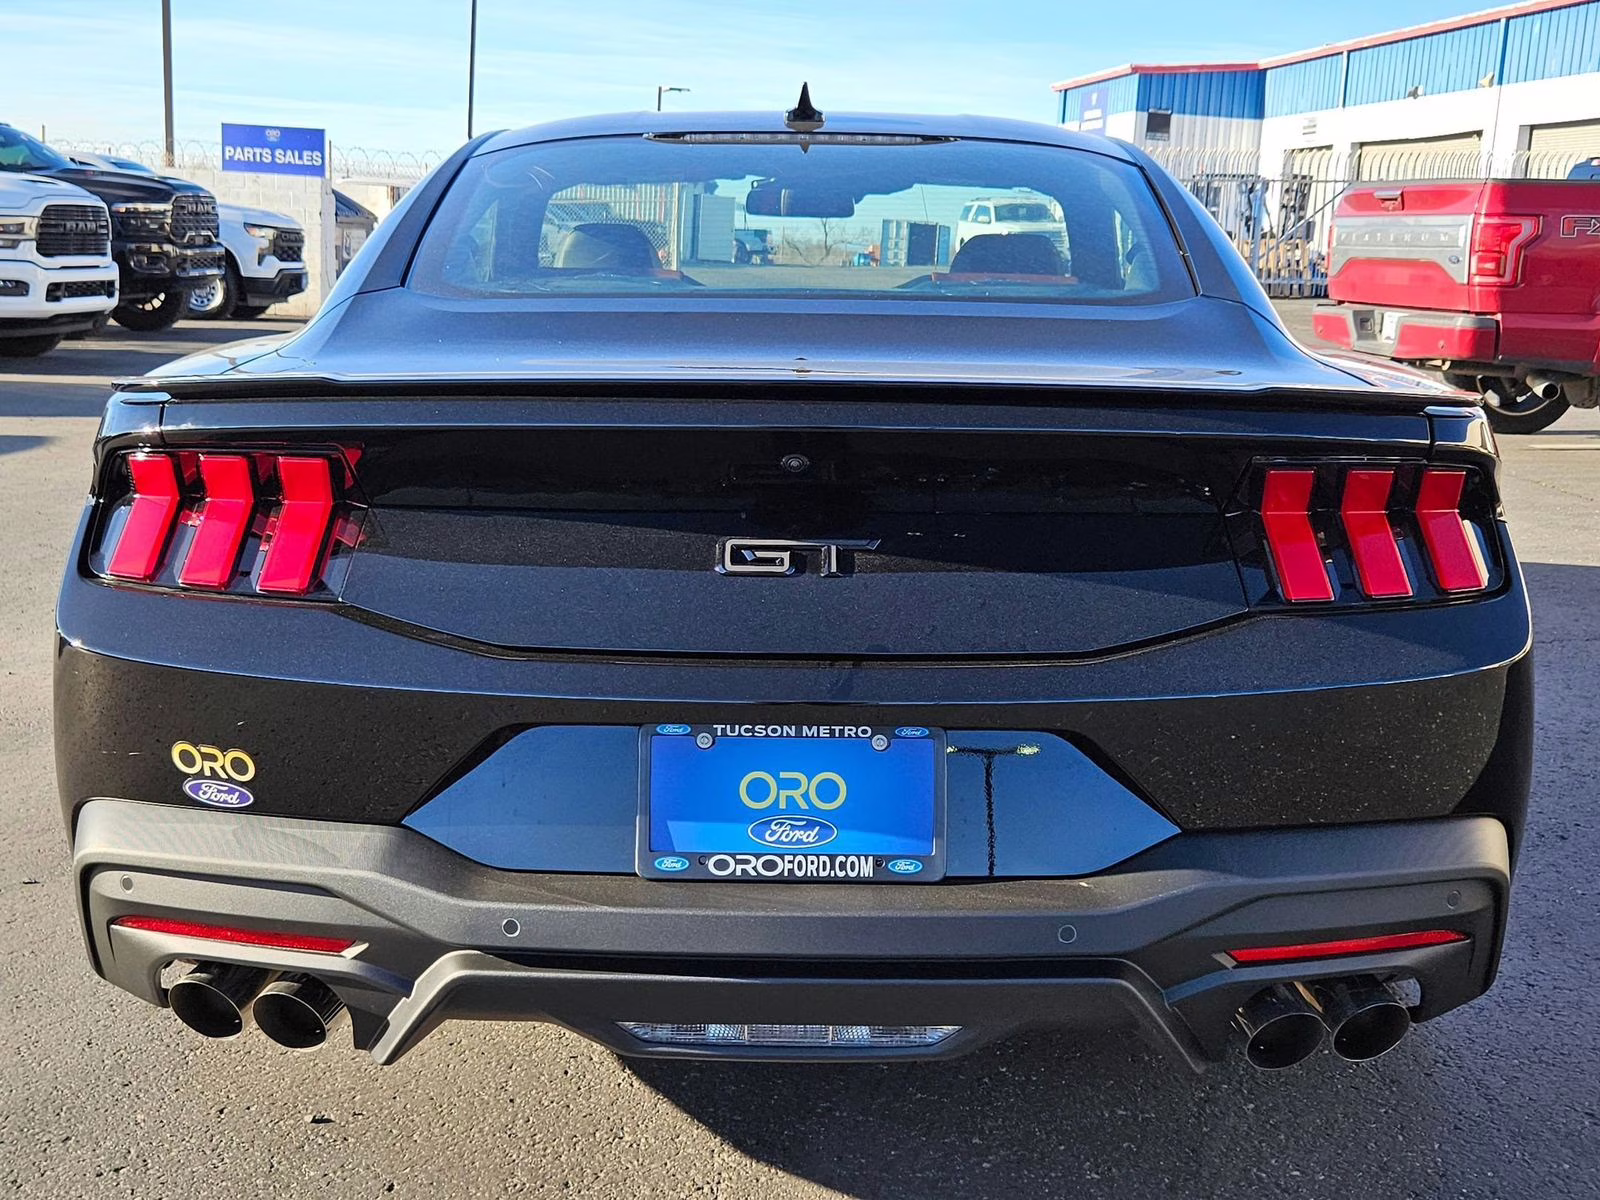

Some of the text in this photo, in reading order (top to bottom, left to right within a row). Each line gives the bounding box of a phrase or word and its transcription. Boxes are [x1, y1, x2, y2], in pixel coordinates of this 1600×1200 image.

[225, 146, 322, 166] PARTS SALES
[187, 203, 212, 213] RAM
[66, 221, 96, 233] RAM
[715, 538, 881, 576] GT
[713, 724, 872, 738] TUCSON METRO
[901, 728, 921, 736] Ford
[171, 741, 256, 782] ORO
[199, 783, 240, 804] Ford
[739, 771, 847, 810] ORO
[765, 819, 820, 843] Ford
[661, 858, 682, 868] Ford
[708, 855, 874, 877] OROFORD.COM
[895, 861, 915, 871] Ford
